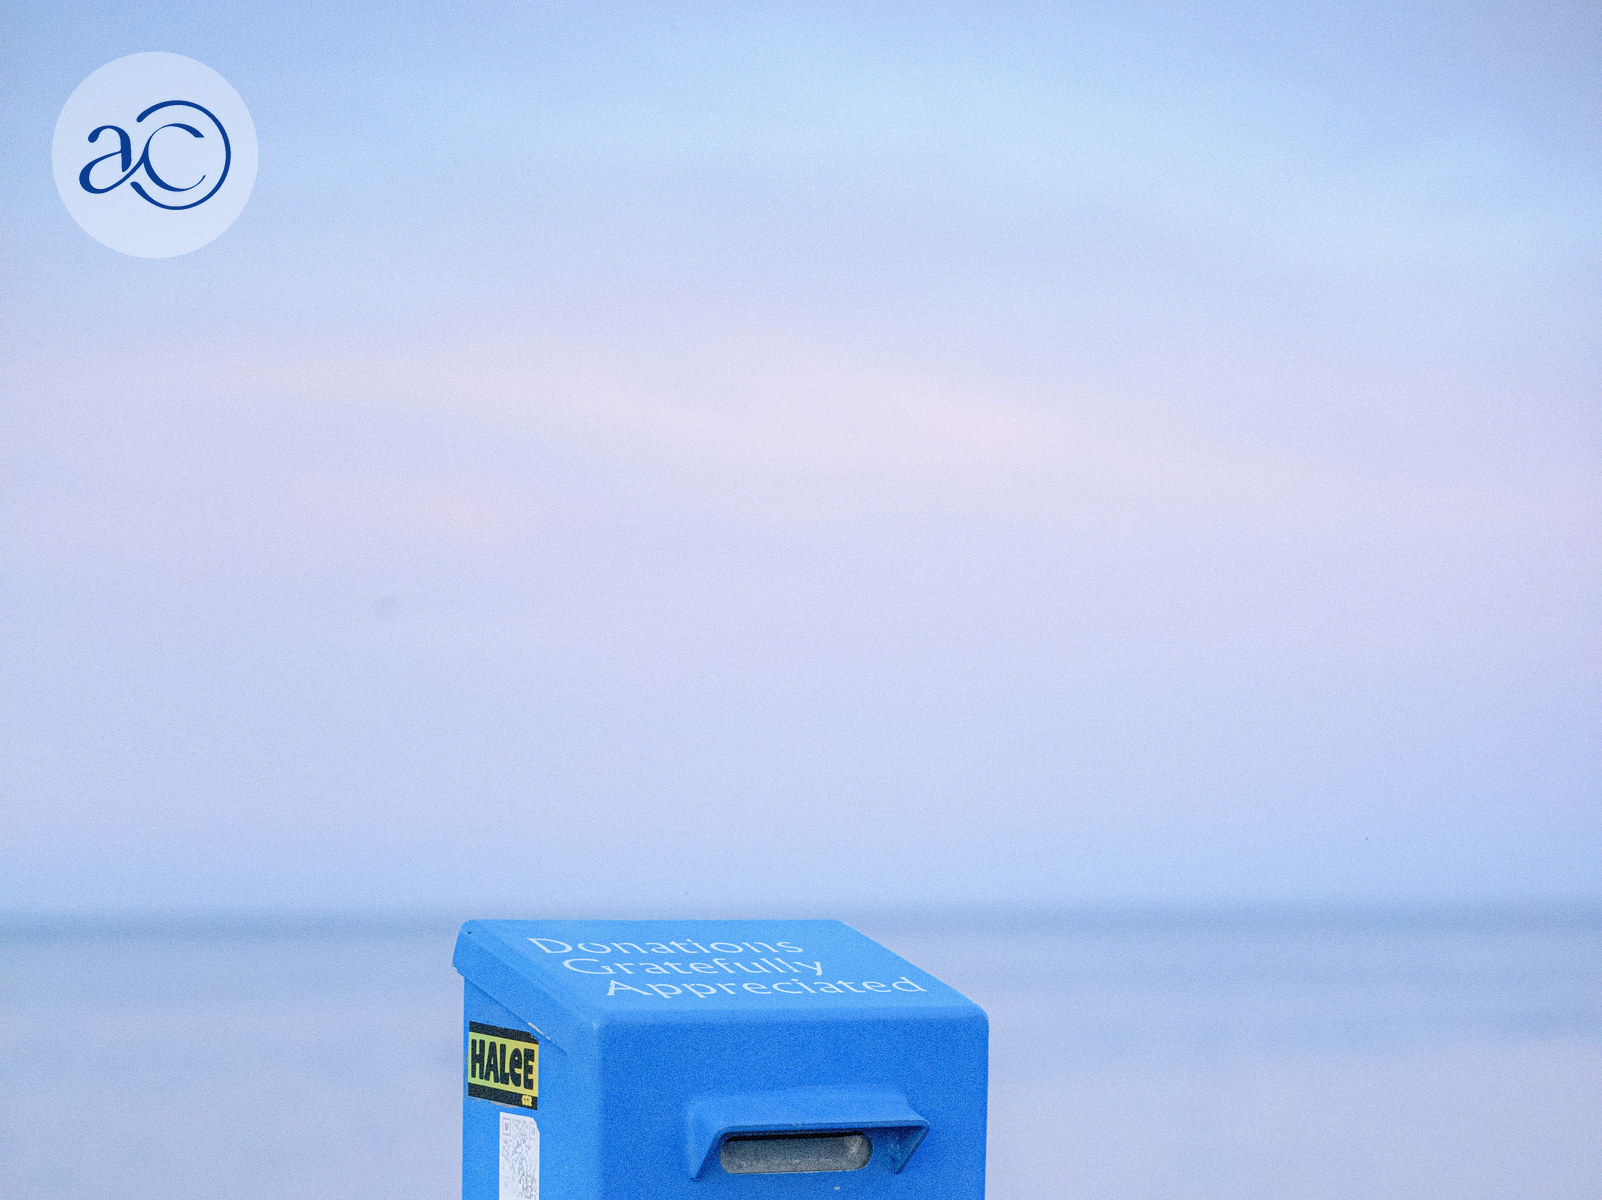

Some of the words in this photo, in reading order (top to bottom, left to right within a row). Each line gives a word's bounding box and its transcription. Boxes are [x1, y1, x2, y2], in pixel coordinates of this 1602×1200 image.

[526, 937, 804, 954] Donations
[562, 957, 824, 976] Gratefully
[606, 977, 928, 998] Appreciated
